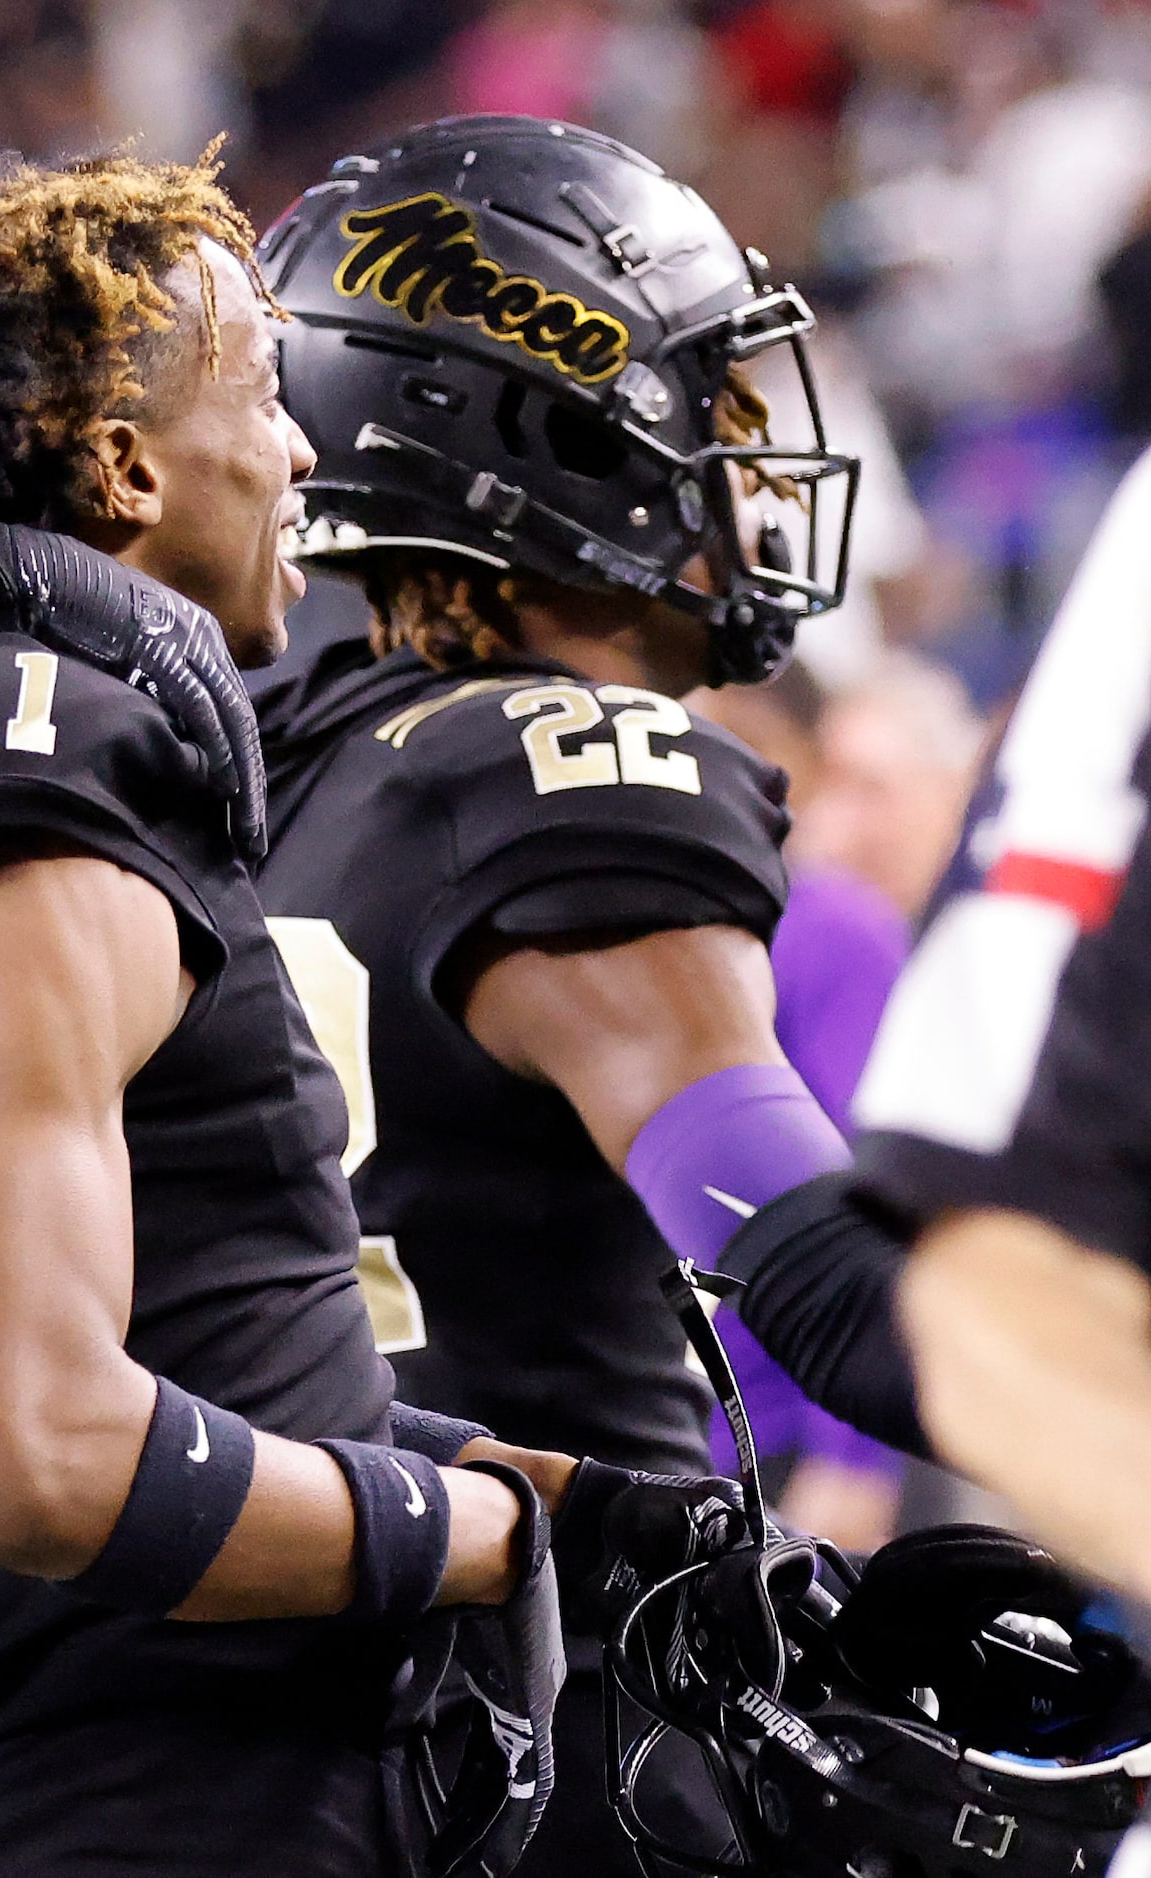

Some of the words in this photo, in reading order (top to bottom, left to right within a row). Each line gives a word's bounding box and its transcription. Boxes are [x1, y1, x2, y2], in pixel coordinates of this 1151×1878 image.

[333, 190, 632, 385] Mecca
[6, 651, 59, 756] 1
[501, 683, 703, 796] 22
[736, 1685, 817, 1754] schutt
